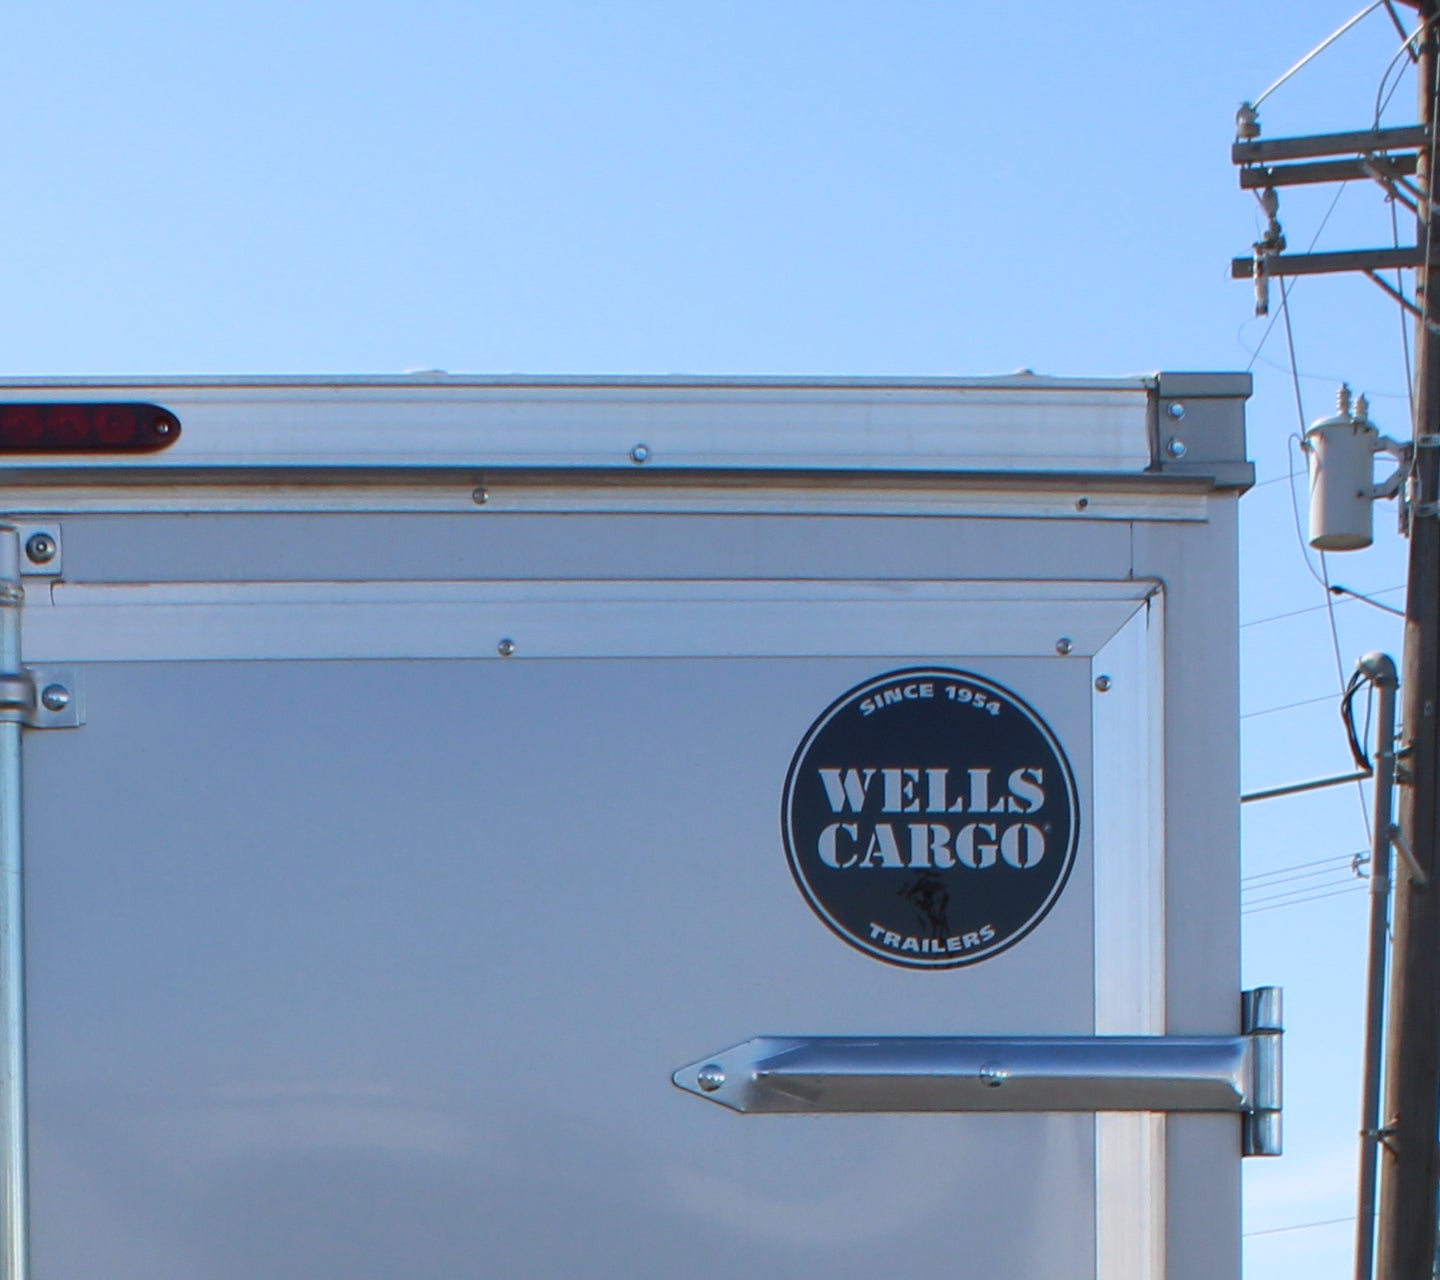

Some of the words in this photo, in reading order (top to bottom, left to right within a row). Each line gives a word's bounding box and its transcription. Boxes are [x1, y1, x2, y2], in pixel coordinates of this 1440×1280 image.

[860, 683, 934, 716] SINCE
[945, 686, 1002, 716] 1954
[818, 767, 1045, 813] WELLS
[817, 822, 1046, 869] CARGO
[869, 922, 996, 952] TRAILERS
